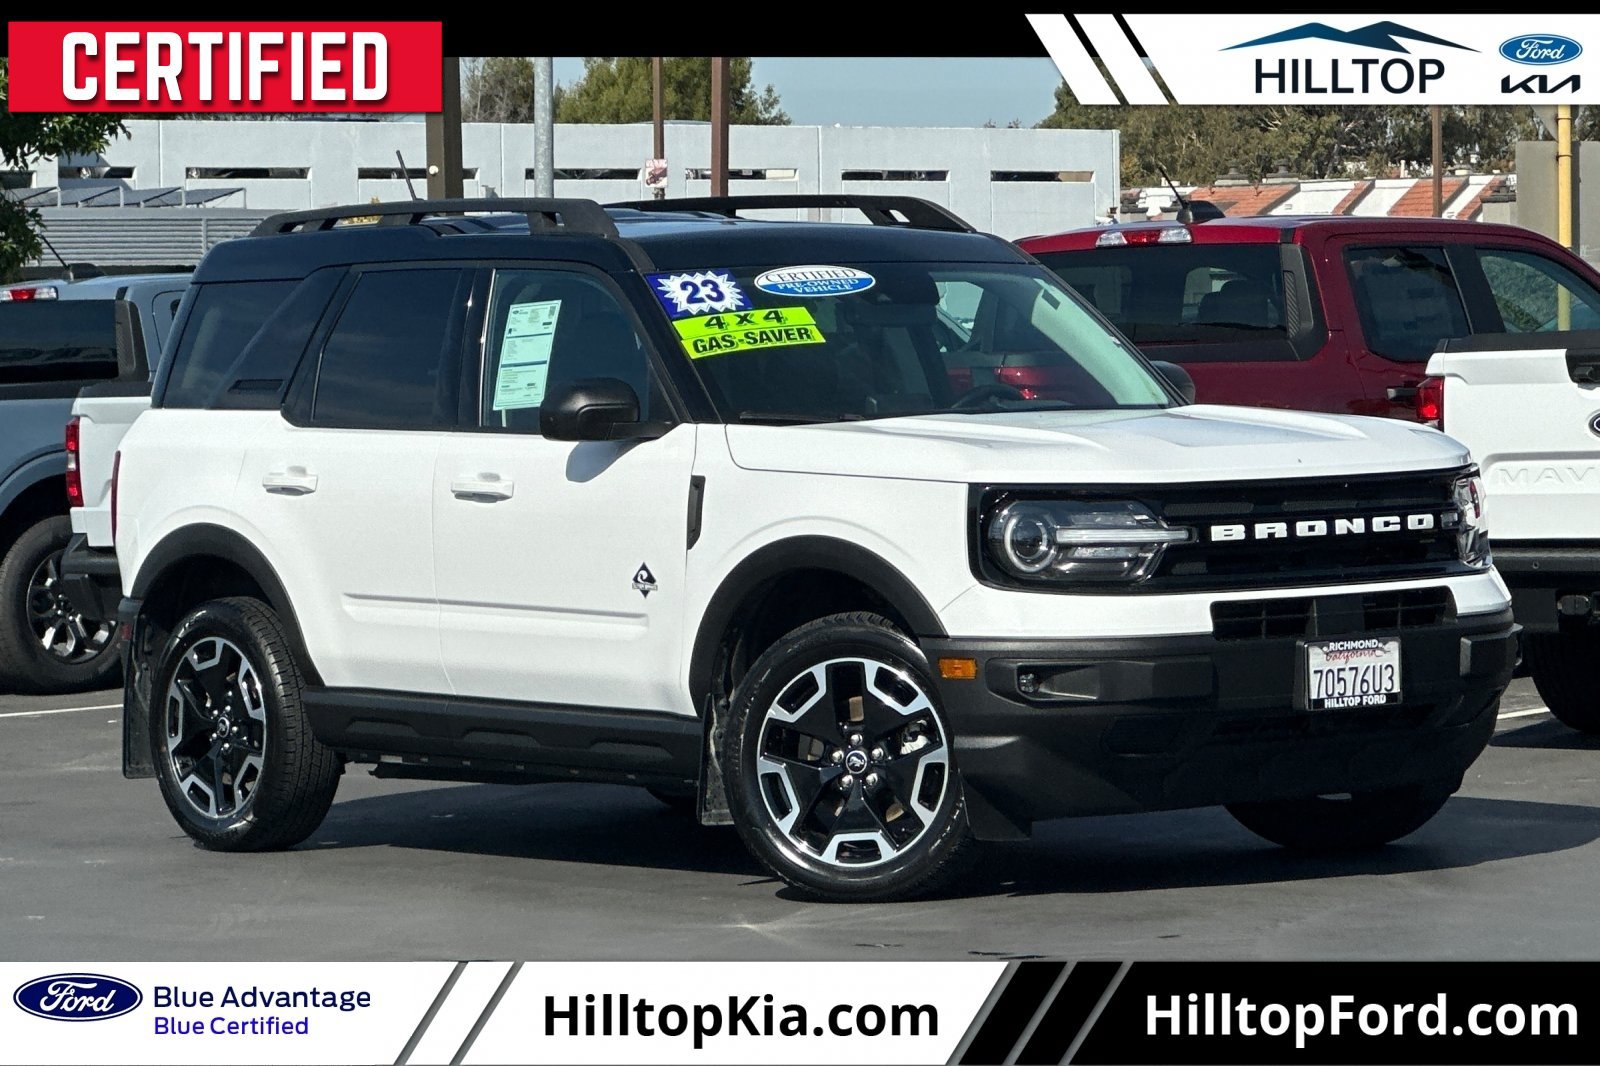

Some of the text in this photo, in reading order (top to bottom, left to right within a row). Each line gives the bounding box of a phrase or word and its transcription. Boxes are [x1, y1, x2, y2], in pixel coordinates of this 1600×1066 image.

[764, 267, 857, 284] CERTIFIED
[680, 279, 725, 305] 23
[777, 278, 860, 291] PRE-OWNED
[793, 284, 853, 294] VEHICLE
[692, 327, 815, 354] GAS-SAVER
[1210, 513, 1434, 542] BRONCO
[1329, 639, 1379, 651] RICHMOND
[1325, 649, 1381, 664] California
[1313, 664, 1394, 699] 70576U3
[1324, 694, 1387, 709] HILLTOP FORD
